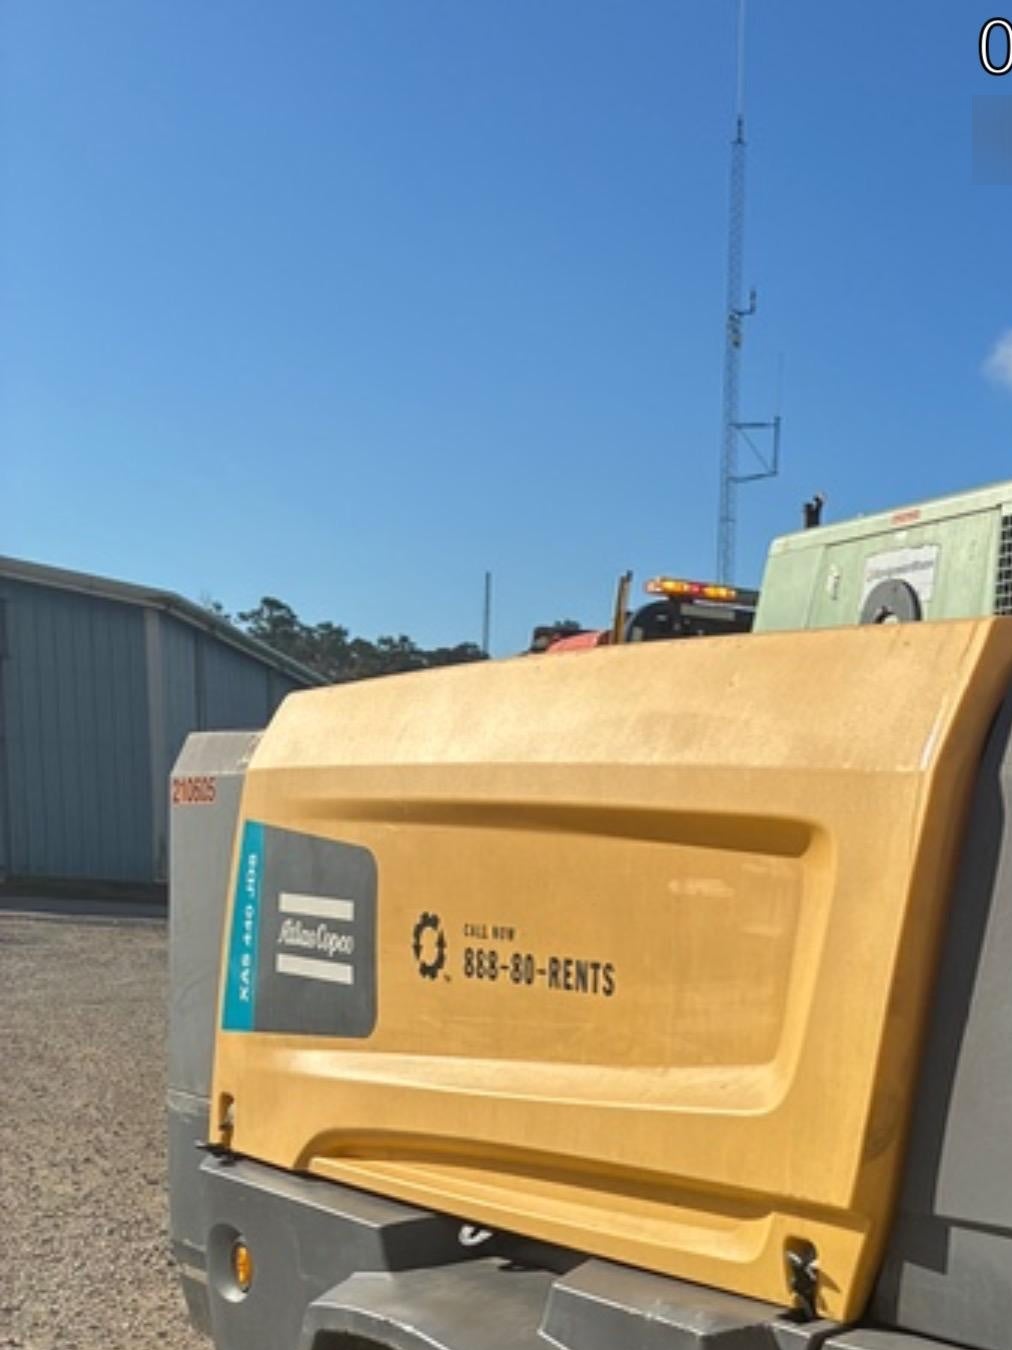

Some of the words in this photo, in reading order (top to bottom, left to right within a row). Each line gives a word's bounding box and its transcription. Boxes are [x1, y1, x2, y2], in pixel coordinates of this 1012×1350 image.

[278, 918, 315, 949] Atlas
[316, 923, 353, 957] Copco
[463, 923, 488, 940] CALL
[491, 926, 515, 942] NOW
[463, 947, 616, 997] 888-80-RENTS
